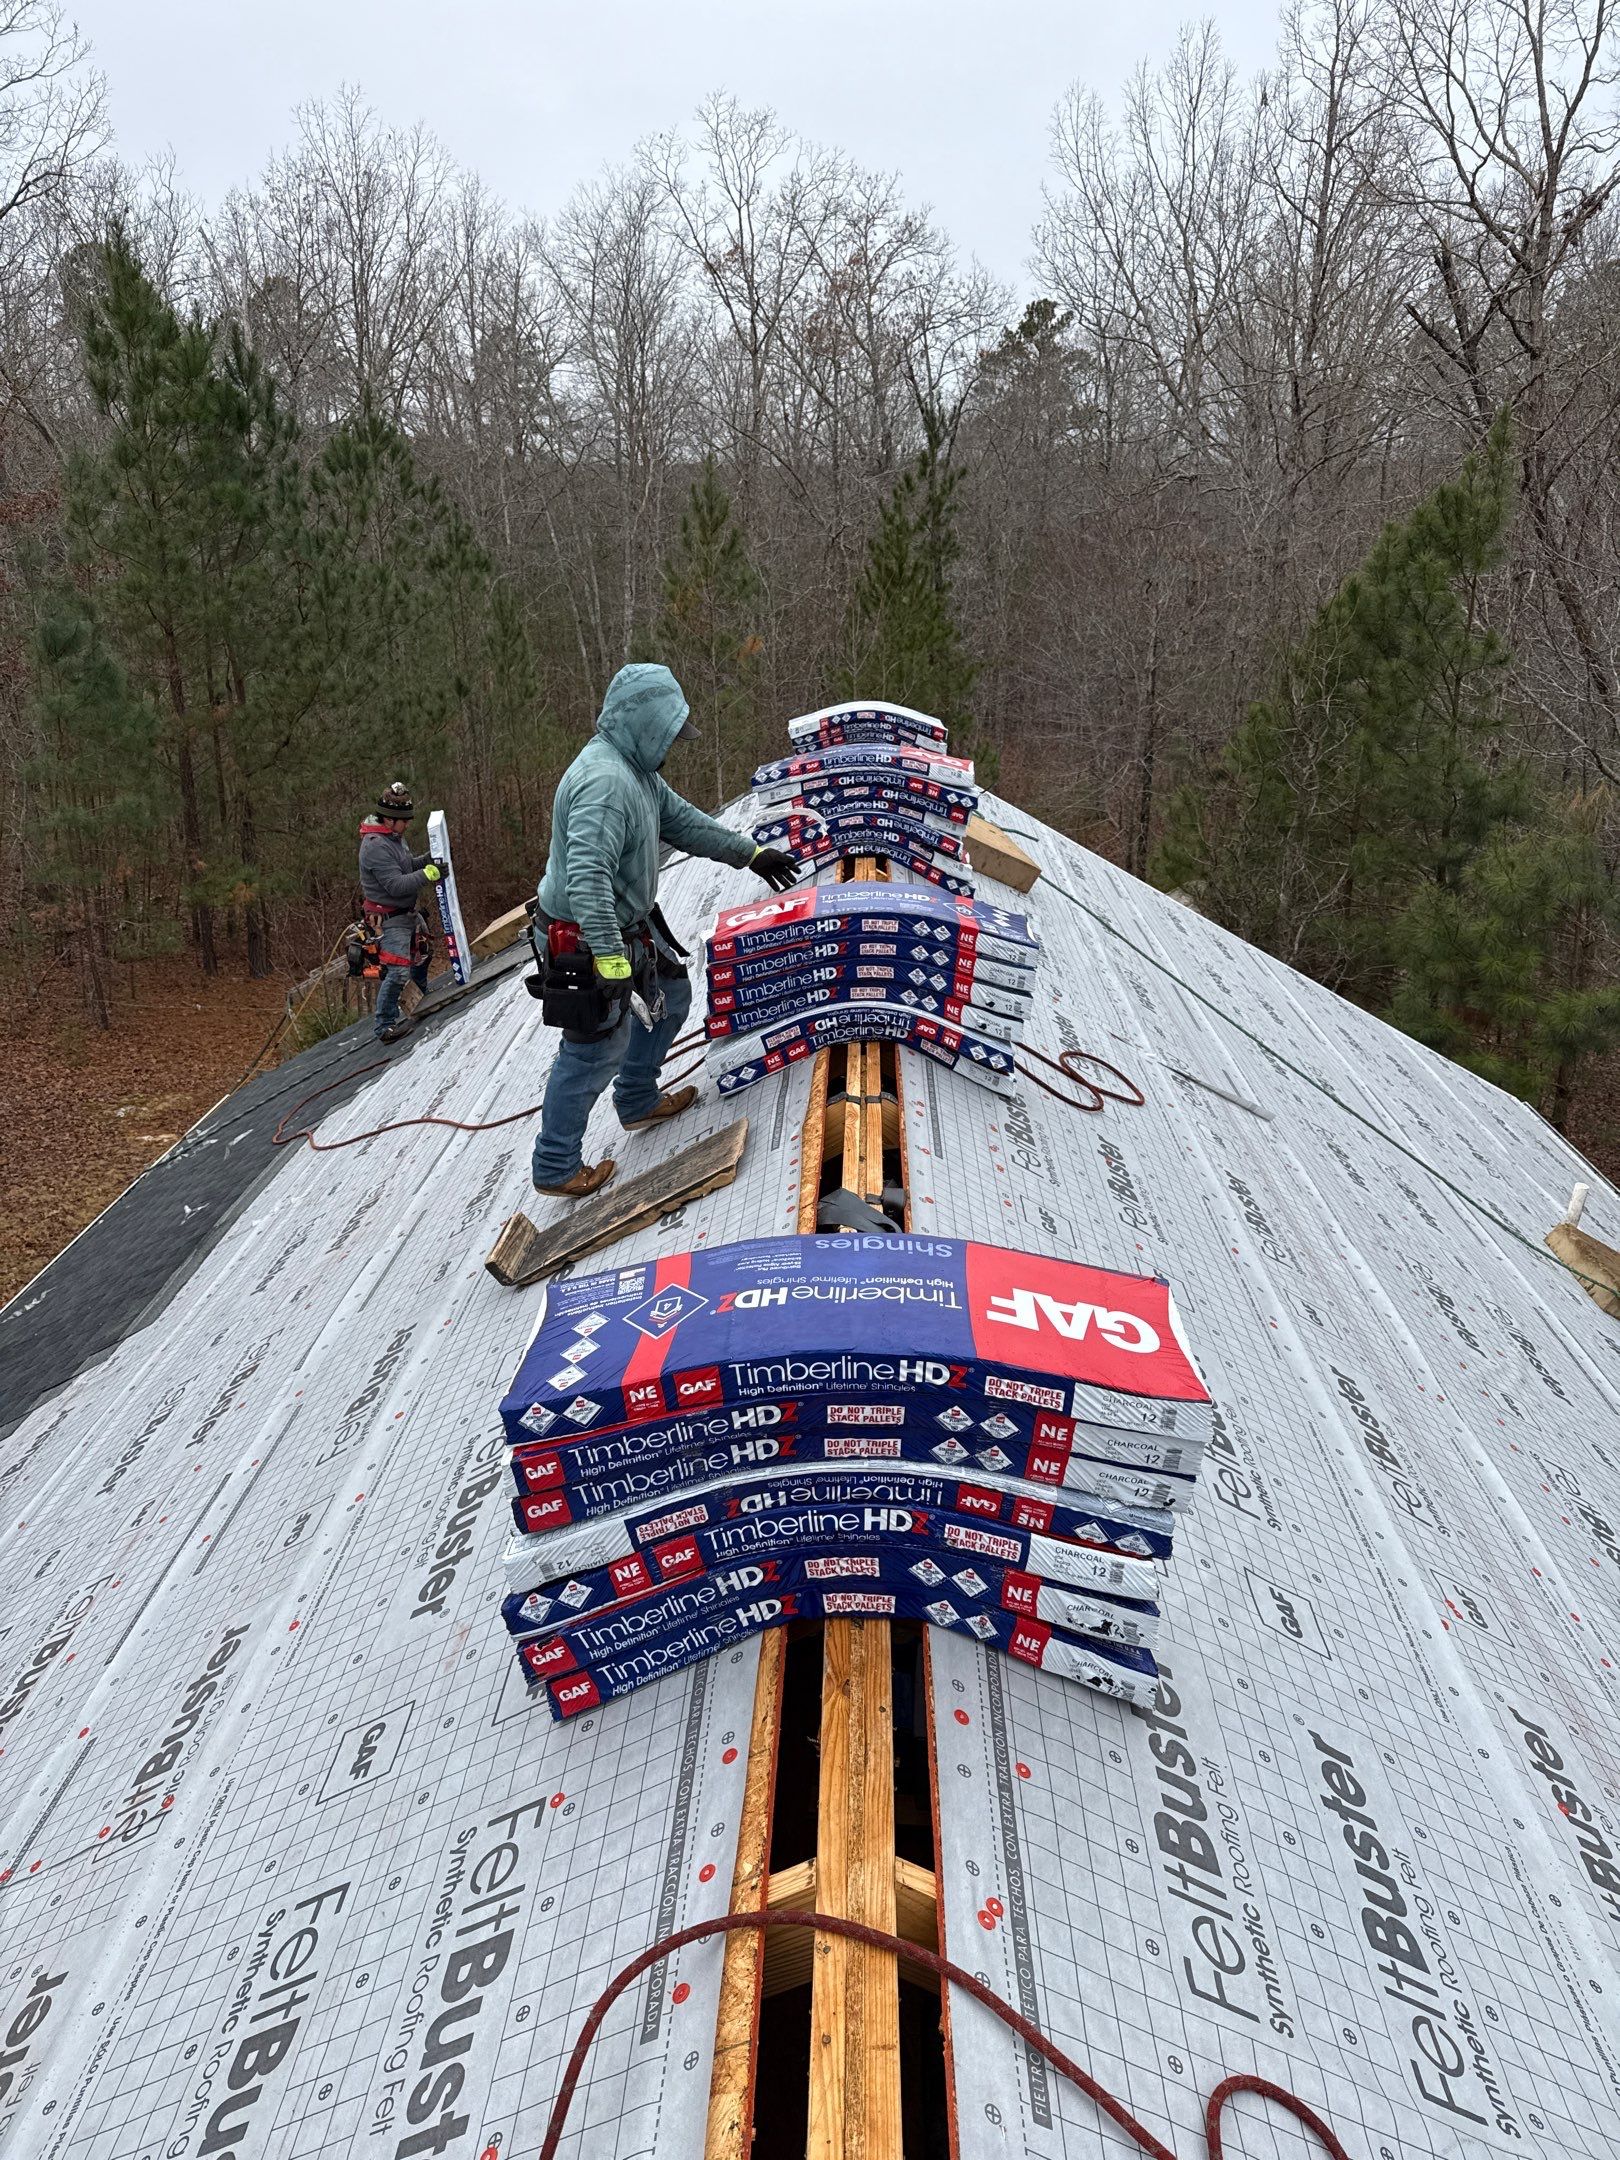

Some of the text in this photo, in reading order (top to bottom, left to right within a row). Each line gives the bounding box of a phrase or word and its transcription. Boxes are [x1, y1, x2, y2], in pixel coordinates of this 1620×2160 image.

[823, 753, 875, 766] Timberline
[855, 775, 905, 786] Timberline
[821, 802, 872, 817] Timberline
[832, 829, 883, 842] Timberline
[820, 890, 903, 902] Timberline
[726, 897, 809, 927] GAF
[714, 942, 733, 952] GAF
[738, 923, 816, 948] Timberline
[960, 933, 975, 943] NE
[714, 971, 732, 981] GAF
[737, 948, 814, 977] Timberline
[959, 957, 973, 968] NE
[714, 995, 732, 1005] GAF
[737, 972, 812, 1002] Timberline
[709, 1020, 728, 1030] GAF
[732, 996, 806, 1025] Timberline
[946, 1003, 960, 1015] NE
[839, 1012, 936, 1034] Timberline GAF
[789, 1045, 806, 1057] GAF
[810, 1024, 885, 1047] Timberline
[1097, 1134, 1152, 1238] FeltBuster
[1038, 1207, 1058, 1235] GAF
[1224, 1170, 1294, 1270] FeltBuster
[815, 1236, 953, 1258] Shingles
[757, 1276, 807, 1285] Shingles
[928, 1277, 954, 1288] High
[792, 1286, 962, 1310] Timberline
[1406, 1255, 1488, 1360] FeltBuster
[986, 1287, 1161, 1354] GAF
[1484, 1300, 1574, 1408] FeltBuster
[185, 1327, 285, 1450] FeltBuster
[629, 1386, 658, 1403] NE
[680, 1378, 717, 1395] GAF
[729, 1355, 894, 1387] Timberline
[738, 1387, 765, 1397] High
[871, 1383, 916, 1392] Shingles
[988, 1378, 1062, 1400] DO NOT TRIPLE
[315, 1322, 418, 1468] FeltBuster
[988, 1387, 1061, 1409] STACK PALLETS
[1103, 1395, 1154, 1412] CHARCOAL
[829, 1406, 902, 1416] DO NOT TRIPLE
[829, 1414, 902, 1425] STACK PALLETS
[1141, 1412, 1157, 1423] 12
[95, 1373, 201, 1498] FeltBuster
[568, 1418, 729, 1466] Timberline
[1040, 1423, 1068, 1441] NE
[1107, 1439, 1160, 1451] CHARCOAL
[1144, 1454, 1160, 1465] 12
[1329, 1364, 1434, 1528] FeltBuster
[526, 1462, 557, 1480] GAF
[572, 1452, 729, 1505] Timberline
[580, 1464, 605, 1478] High
[1033, 1458, 1061, 1475] NE
[1098, 1471, 1150, 1485] CHARCOAL
[790, 1485, 943, 1505] Timberline
[1133, 1487, 1149, 1497] 12
[527, 1499, 563, 1519] GAF
[586, 1503, 611, 1517] High
[960, 1495, 1045, 1530] GAF NE
[661, 1548, 695, 1568] GAF
[704, 1510, 860, 1550] Timberline
[948, 1526, 1019, 1550] DO NOT TRIPLE
[950, 1538, 1018, 1560] TACK PALLETS
[1055, 1547, 1105, 1564] CHARCOAL
[614, 1561, 642, 1582] NE
[1091, 1566, 1106, 1578] 12
[1007, 1586, 1033, 1602] NE
[1454, 1585, 1489, 1629] GAF
[571, 1586, 715, 1650] Timberline
[1269, 1587, 1303, 1638] GAF
[531, 1646, 566, 1666] GAF
[596, 1616, 736, 1684] Timberline
[1016, 1633, 1041, 1653] NE
[559, 1681, 592, 1702] GAF
[988, 1651, 1004, 1731] INCORPORADA
[687, 1698, 702, 1727] PARA
[112, 1623, 252, 1843] eltBuster
[348, 1720, 387, 1780] GAF
[676, 1779, 691, 1806] CON
[1006, 1831, 1018, 1860] CON
[1201, 1756, 1295, 2039] Synthetic Roofing Felt
[1014, 1926, 1027, 1962] PARA
[369, 1825, 478, 2137] Synthetic Roofing Felt
[399, 1796, 548, 2160] FeltBust
[1399, 1847, 1521, 2139] Synthetic Roofing Felt
[168, 1907, 287, 2160] Synthetic Roofing
[1030, 2053, 1048, 2117] FIELTRO
